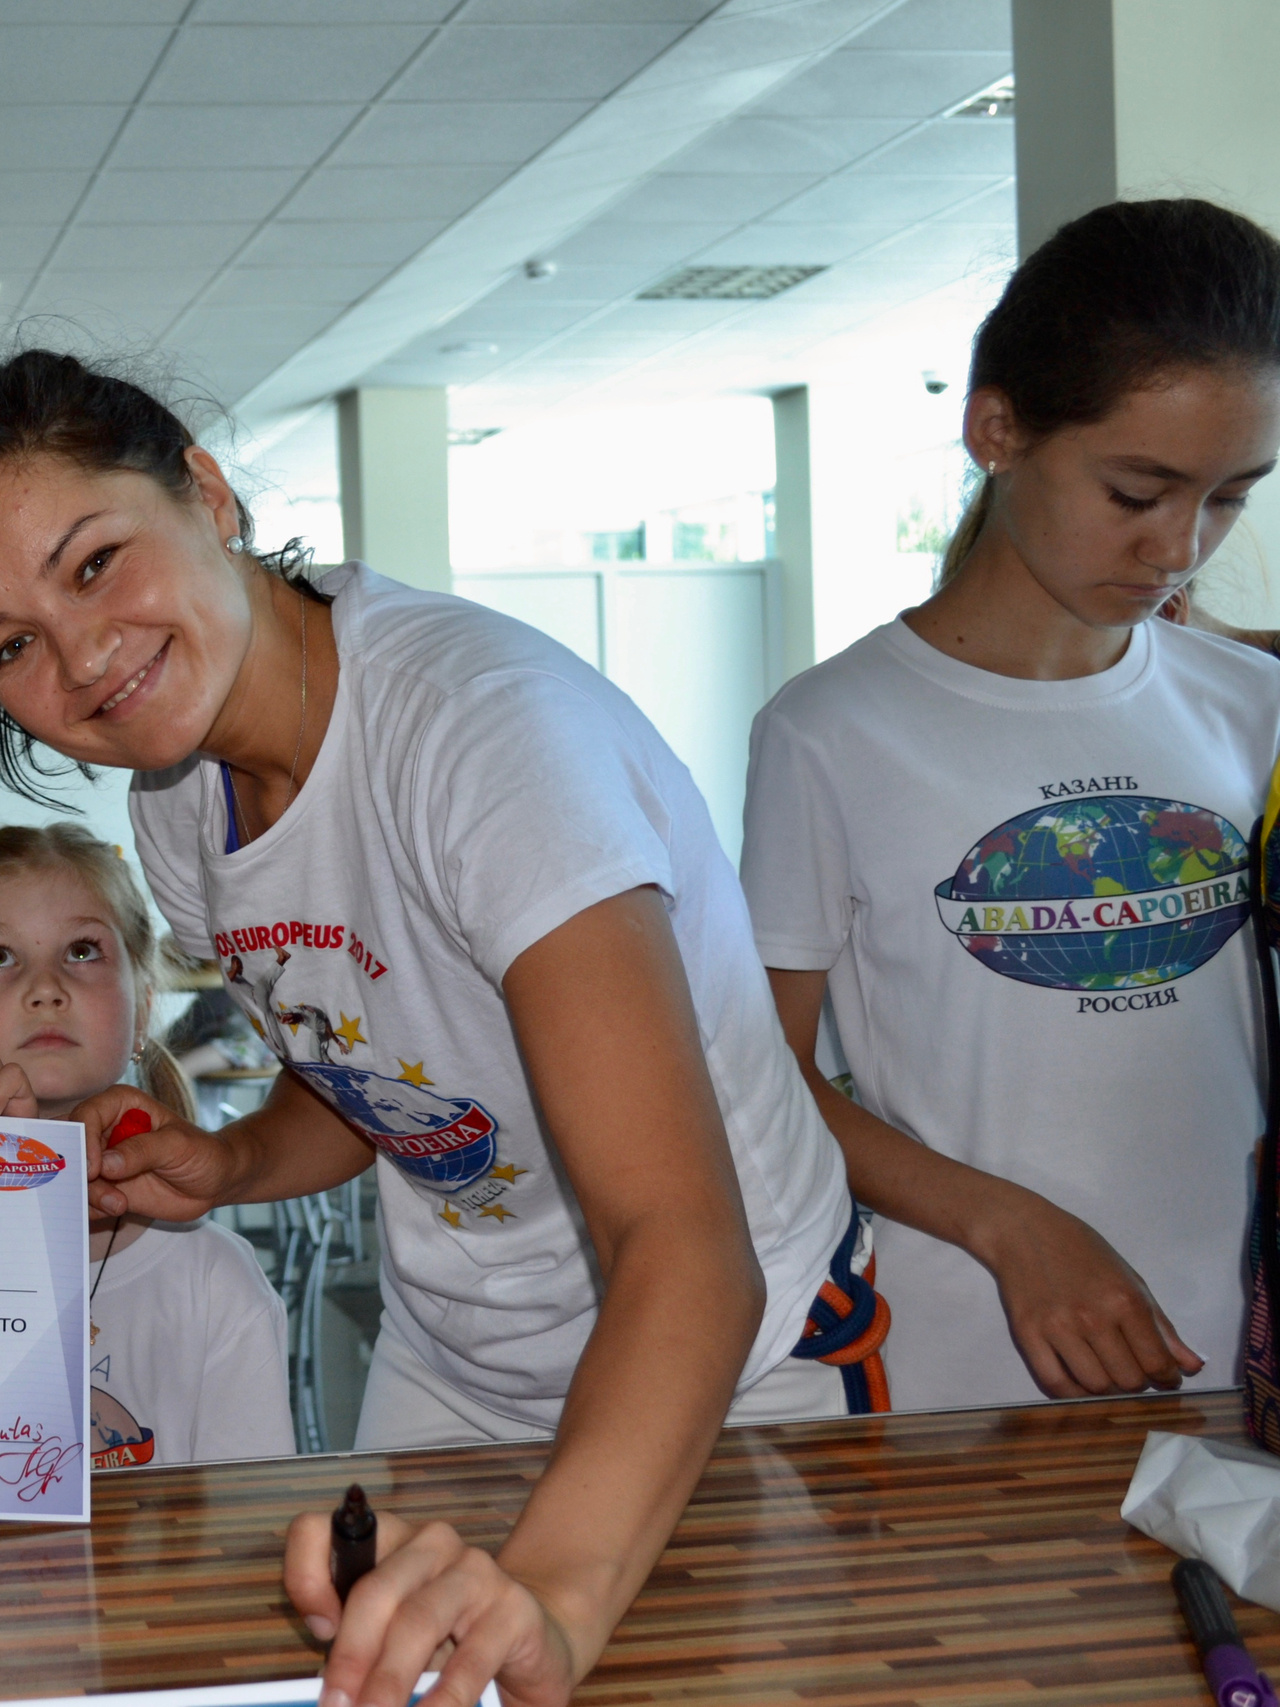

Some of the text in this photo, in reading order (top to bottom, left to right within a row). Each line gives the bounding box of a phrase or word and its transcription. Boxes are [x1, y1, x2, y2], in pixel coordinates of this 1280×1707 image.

[1038, 775, 1139, 800] КАЗАНЬ
[956, 875, 1251, 933] ABADÁ-CAPOEIRA
[231, 920, 346, 954] EUROPEUS
[347, 931, 389, 981] 2017
[1076, 986, 1180, 1014] РОССИЯ
